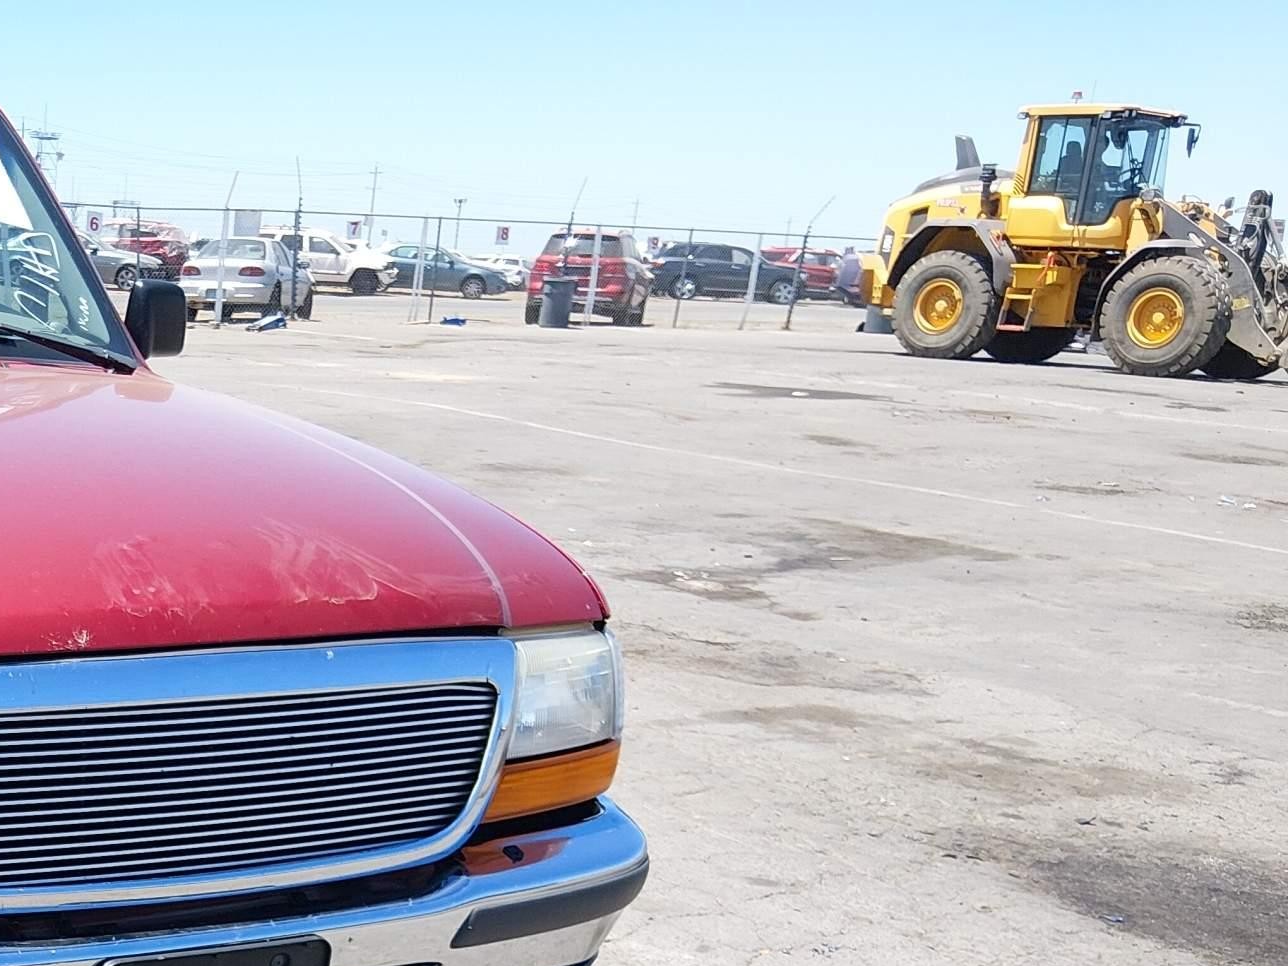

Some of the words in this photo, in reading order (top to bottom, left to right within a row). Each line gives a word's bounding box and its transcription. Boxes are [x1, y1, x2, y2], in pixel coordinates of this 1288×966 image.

[90, 216, 99, 231] 6
[349, 221, 360, 235] 7
[501, 227, 509, 240] 8
